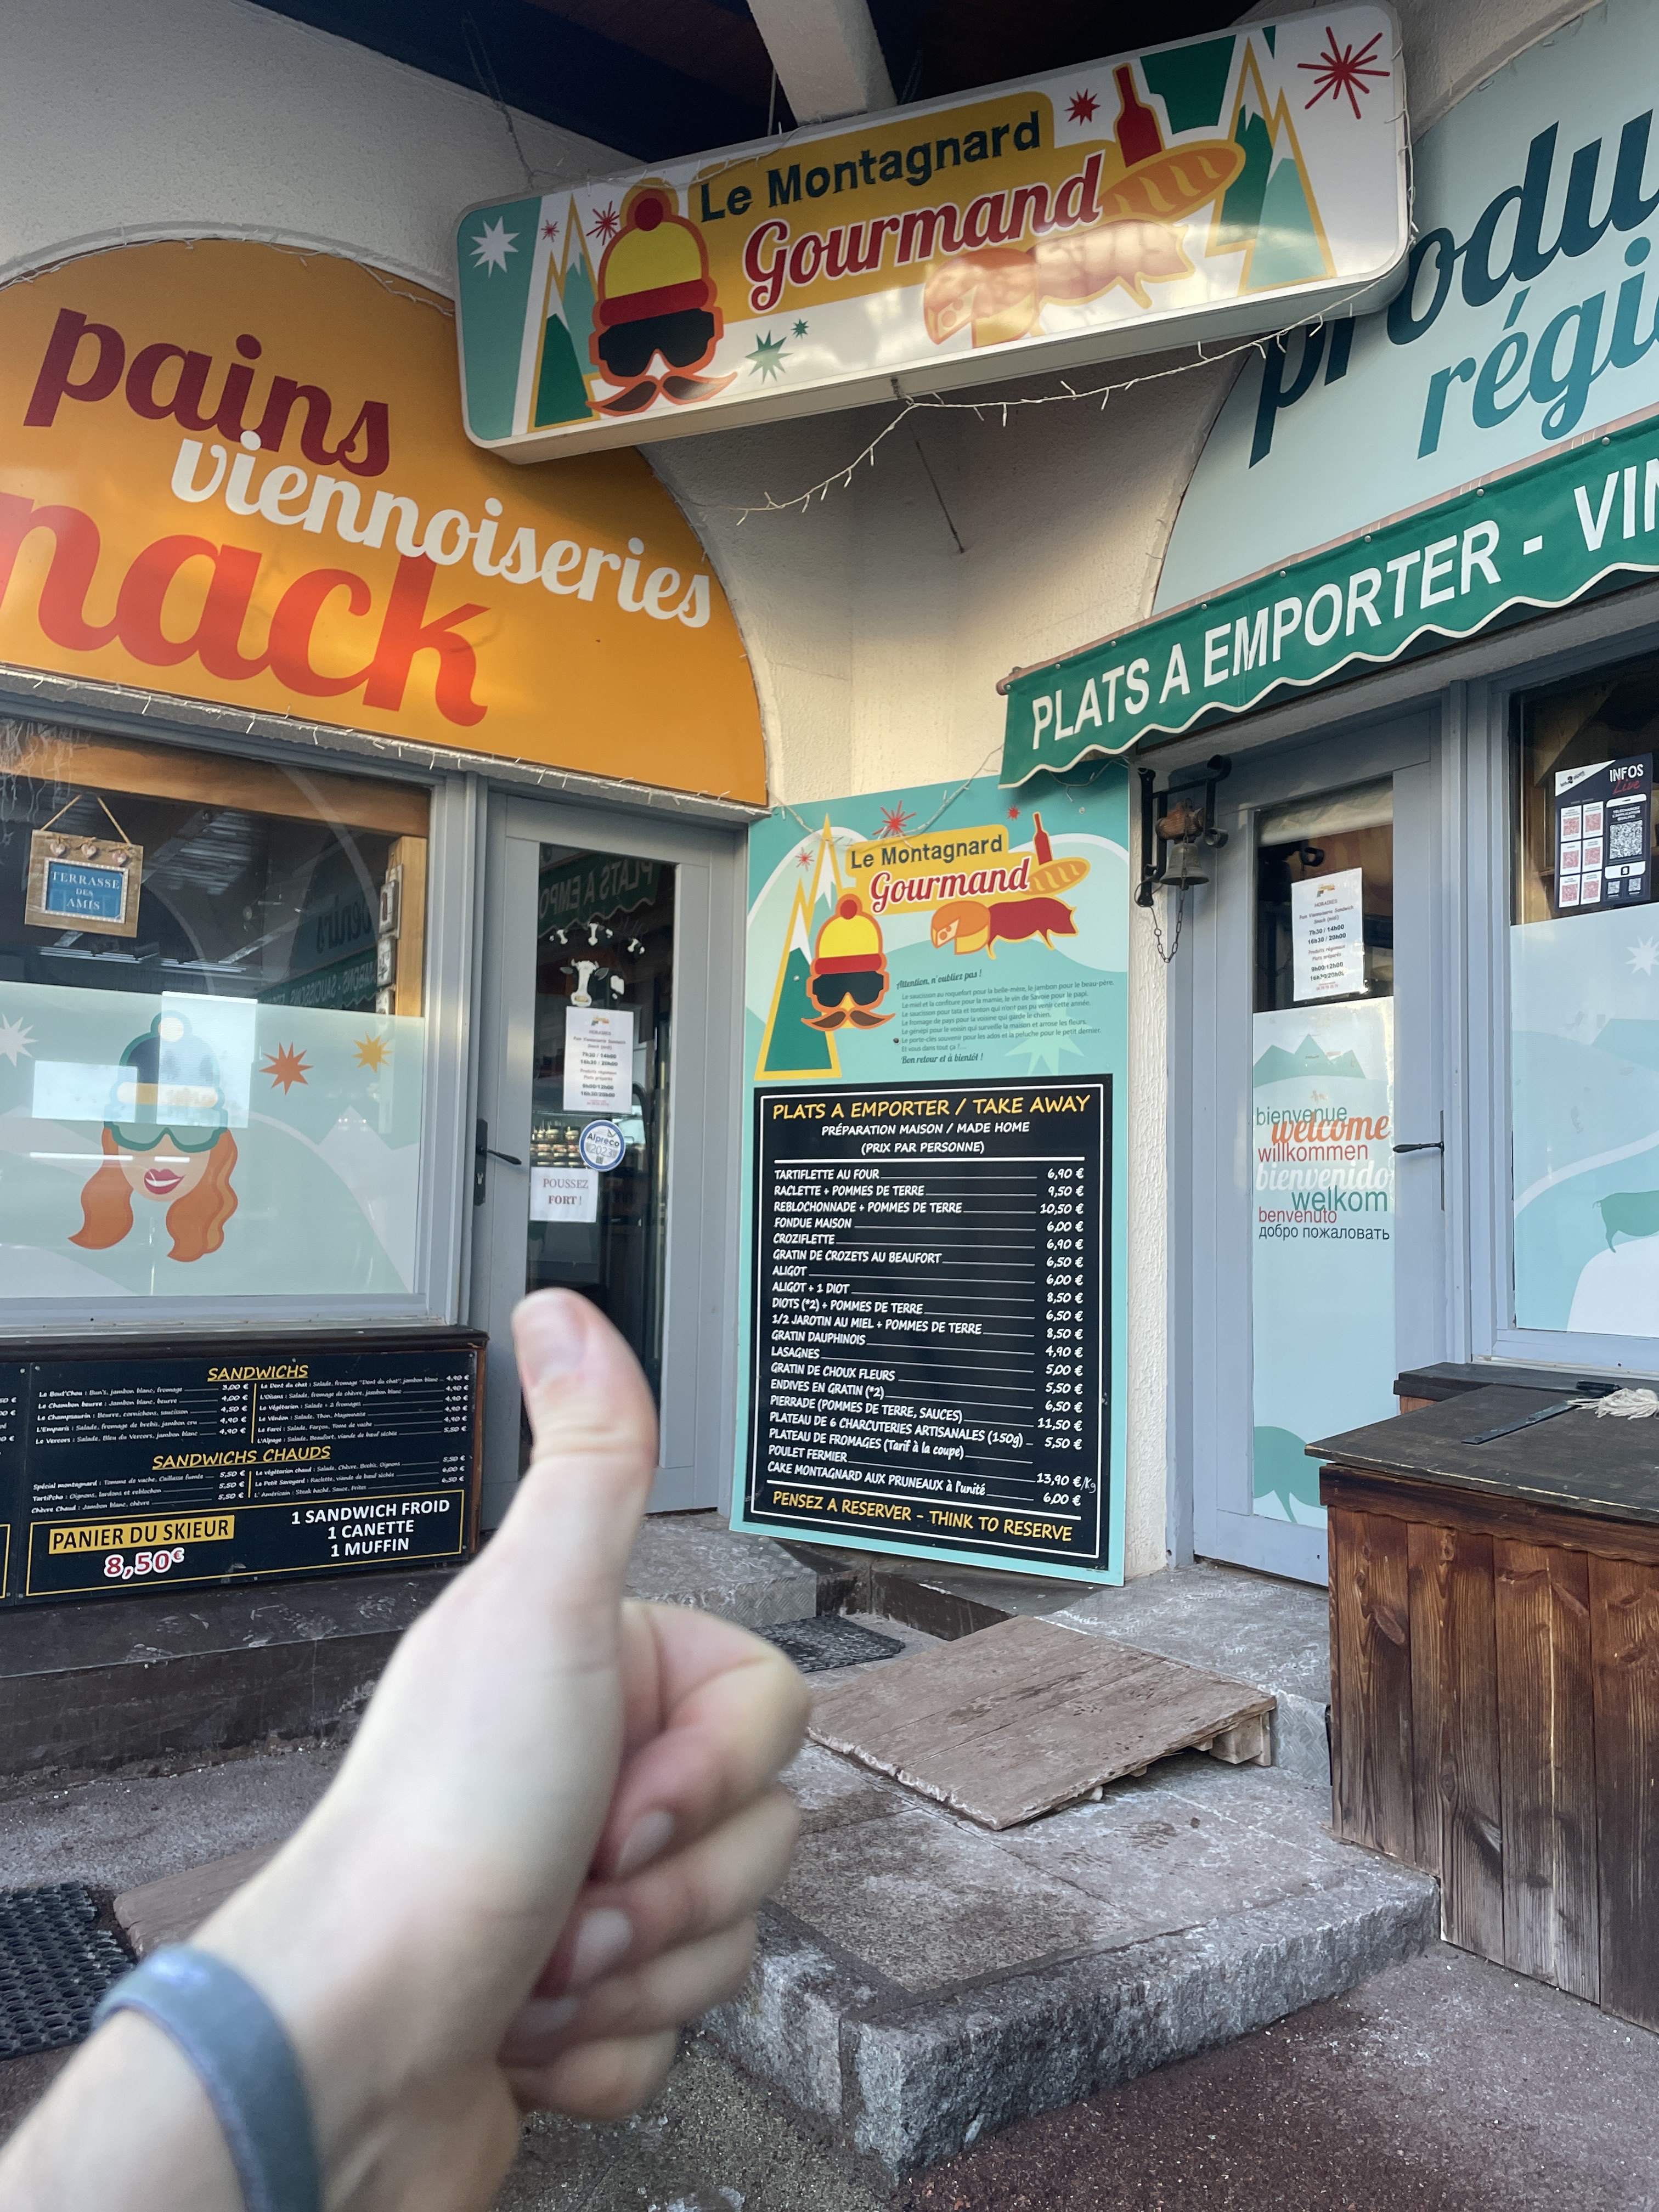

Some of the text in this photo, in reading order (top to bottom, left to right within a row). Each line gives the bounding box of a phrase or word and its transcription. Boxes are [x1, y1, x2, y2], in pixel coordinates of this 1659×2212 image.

[701, 111, 1041, 222] Le Montagnard
[744, 150, 1104, 312] Gourmand
[1417, 236, 1659, 459] régi
[22, 308, 390, 476] pains
[171, 430, 710, 628] viennoiseries
[1033, 659, 1150, 749] PLATS
[1159, 644, 1191, 704] A
[1204, 520, 1502, 687] EMPORTER
[1610, 764, 1644, 782] INFOS
[1612, 778, 1641, 795] Live
[851, 834, 1003, 869] Le Montagnard
[52, 871, 120, 889] TERRASSE
[871, 858, 1030, 912] Gourmand
[76, 888, 93, 896] DES
[66, 898, 100, 910] AMIS
[1327, 924, 1345, 932] 14h00
[1329, 933, 1346, 941] 20h00
[896, 978, 929, 989] Attention,
[931, 973, 962, 984] n'oubliez
[964, 972, 977, 981] pas
[947, 1054, 952, 1062] à
[954, 1053, 978, 1062] bientôt
[774, 1103, 826, 1119] PLATS
[831, 1103, 844, 1118] A
[851, 1100, 950, 1118] EMPORTER
[973, 1097, 1024, 1114] TAKE
[1030, 1094, 1090, 1113] AWAY
[1256, 1107, 1347, 1125] bienvenue
[822, 1122, 896, 1136] PRÉPARATION
[899, 1124, 943, 1134] MAISON
[957, 1122, 991, 1133] MADE
[995, 1121, 1030, 1132] HOME
[1272, 1111, 1391, 1143] welcome
[587, 1132, 619, 1147] Alpreco
[861, 1141, 984, 1155] (PRIX PAR PERSONNE)
[590, 1145, 613, 1157] 2023
[1258, 1142, 1368, 1161] willkommen
[543, 1178, 589, 1188] POUSSEZ
[775, 1167, 1084, 1180] TARTIFLETTE AU FOUR 6,90 €
[1256, 1160, 1391, 1190] bienvenido
[549, 1195, 577, 1205] FORT
[774, 1185, 821, 1196] RACLETTE
[832, 1185, 873, 1196] POMMES
[876, 1186, 890, 1196] DE
[892, 1185, 924, 1196] TERRE
[1048, 1186, 1072, 1198] 9,50
[1075, 1185, 1084, 1197] €
[1291, 1185, 1387, 1211] welkom
[1259, 1206, 1337, 1223] benvenuto
[774, 1217, 1084, 1233] FONDUE MAISON 6,00 €
[1259, 1224, 1390, 1240] добро пожаловать
[773, 1233, 1084, 1250] CROZIFLETTE 6,90 €
[773, 1249, 1083, 1268] GRATIN DE CROZETS AU BEAUFORT 6,50 €
[772, 1265, 1083, 1286] ALIGOT 6,00 €
[771, 1346, 1083, 1376] LASAGNES 5,00 €
[208, 1365, 308, 1380] SANDWICHS
[769, 1428, 964, 1460] PLATEAU DE FROMAGES (Tarif à la coupe)
[153, 1446, 330, 1469] SANDWICHS CHAUDS
[769, 1444, 1096, 1493] POULET FERMIER 13,90 €/Kg
[768, 1461, 1081, 1506] CAKE MONTAGNARD AUX PRUNEAUX à l'unité 6,00 €
[292, 1500, 449, 1524] 1 SANDWICH FROID
[773, 1491, 823, 1509] PENSEZ
[827, 1498, 838, 1512] A
[842, 1499, 911, 1521] RESERVER
[929, 1511, 973, 1528] THINK
[978, 1516, 999, 1532] TO
[1004, 1519, 1073, 1541] RESERVE
[53, 1520, 228, 1550] PANIER DU SKIEUR
[328, 1520, 414, 1539] 1 CANETTE
[331, 1538, 409, 1557] 1 MUFFIN
